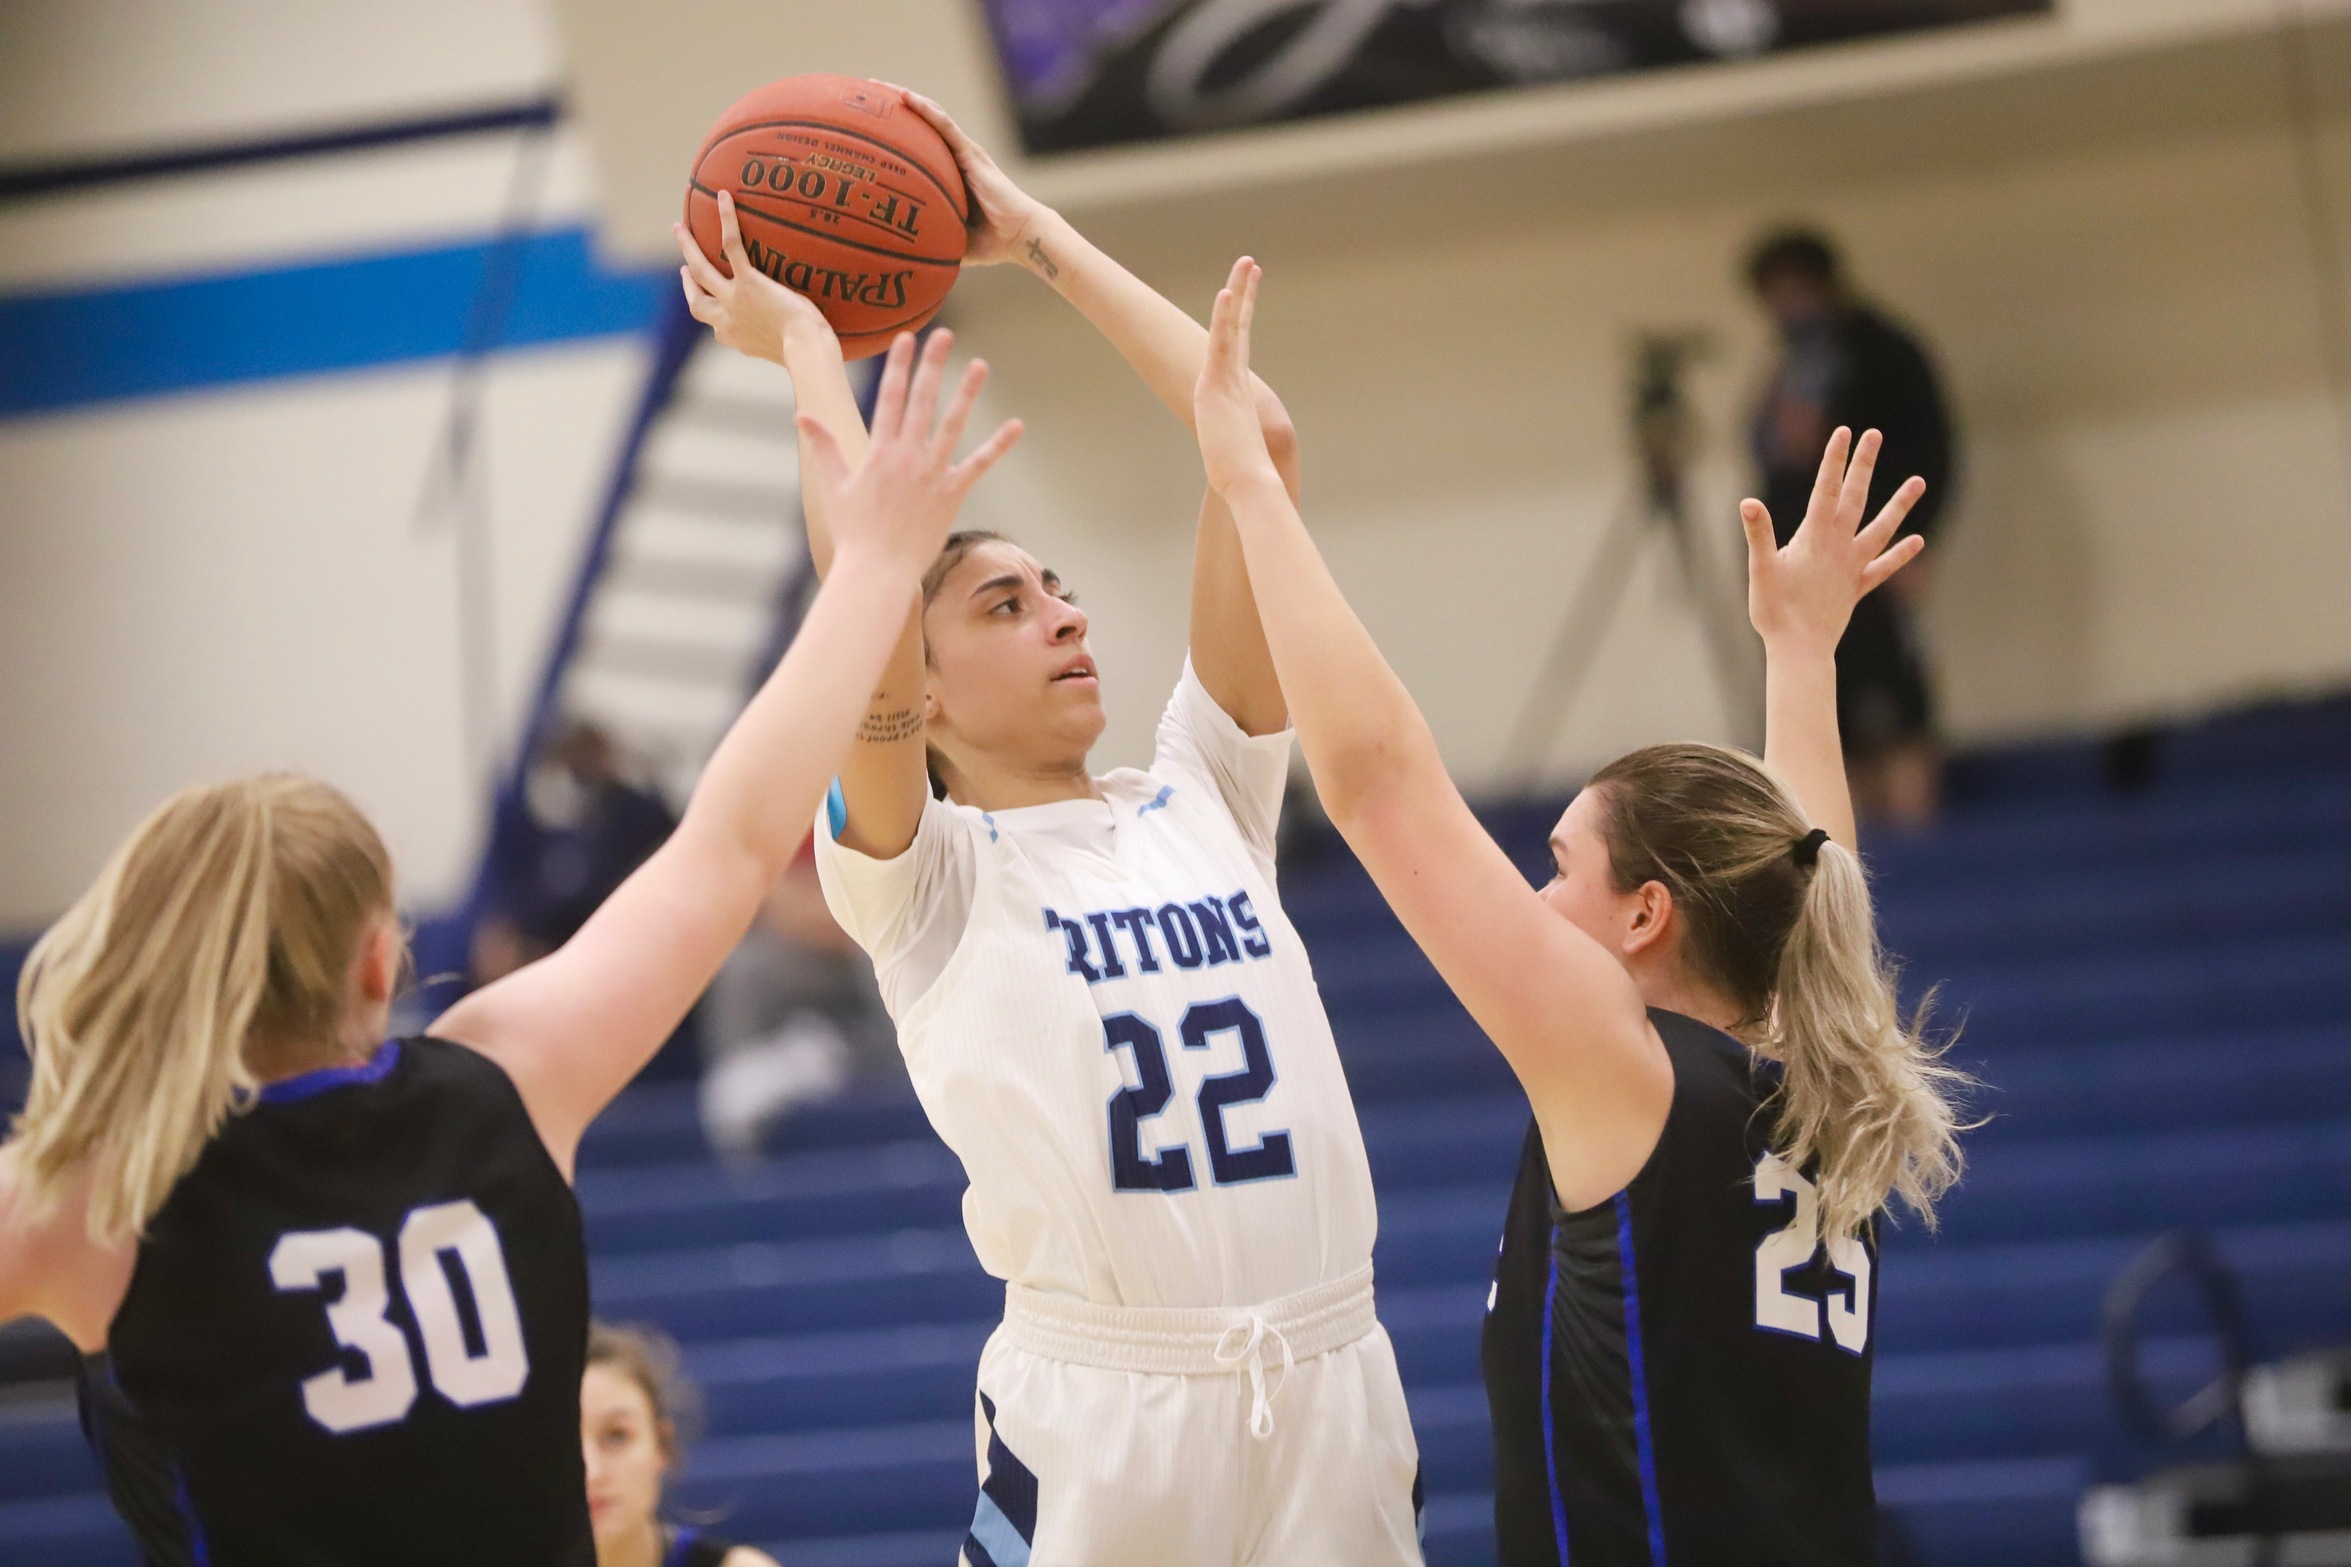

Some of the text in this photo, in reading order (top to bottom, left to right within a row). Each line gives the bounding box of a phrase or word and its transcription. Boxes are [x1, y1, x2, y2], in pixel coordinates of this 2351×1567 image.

[776, 131, 907, 177] DEEP CHANNEL DESIGN
[802, 151, 877, 184] LEGACY
[719, 228, 914, 309] SPALDIN
[1101, 993, 1299, 1195] 22
[267, 1197, 531, 1436] 30
